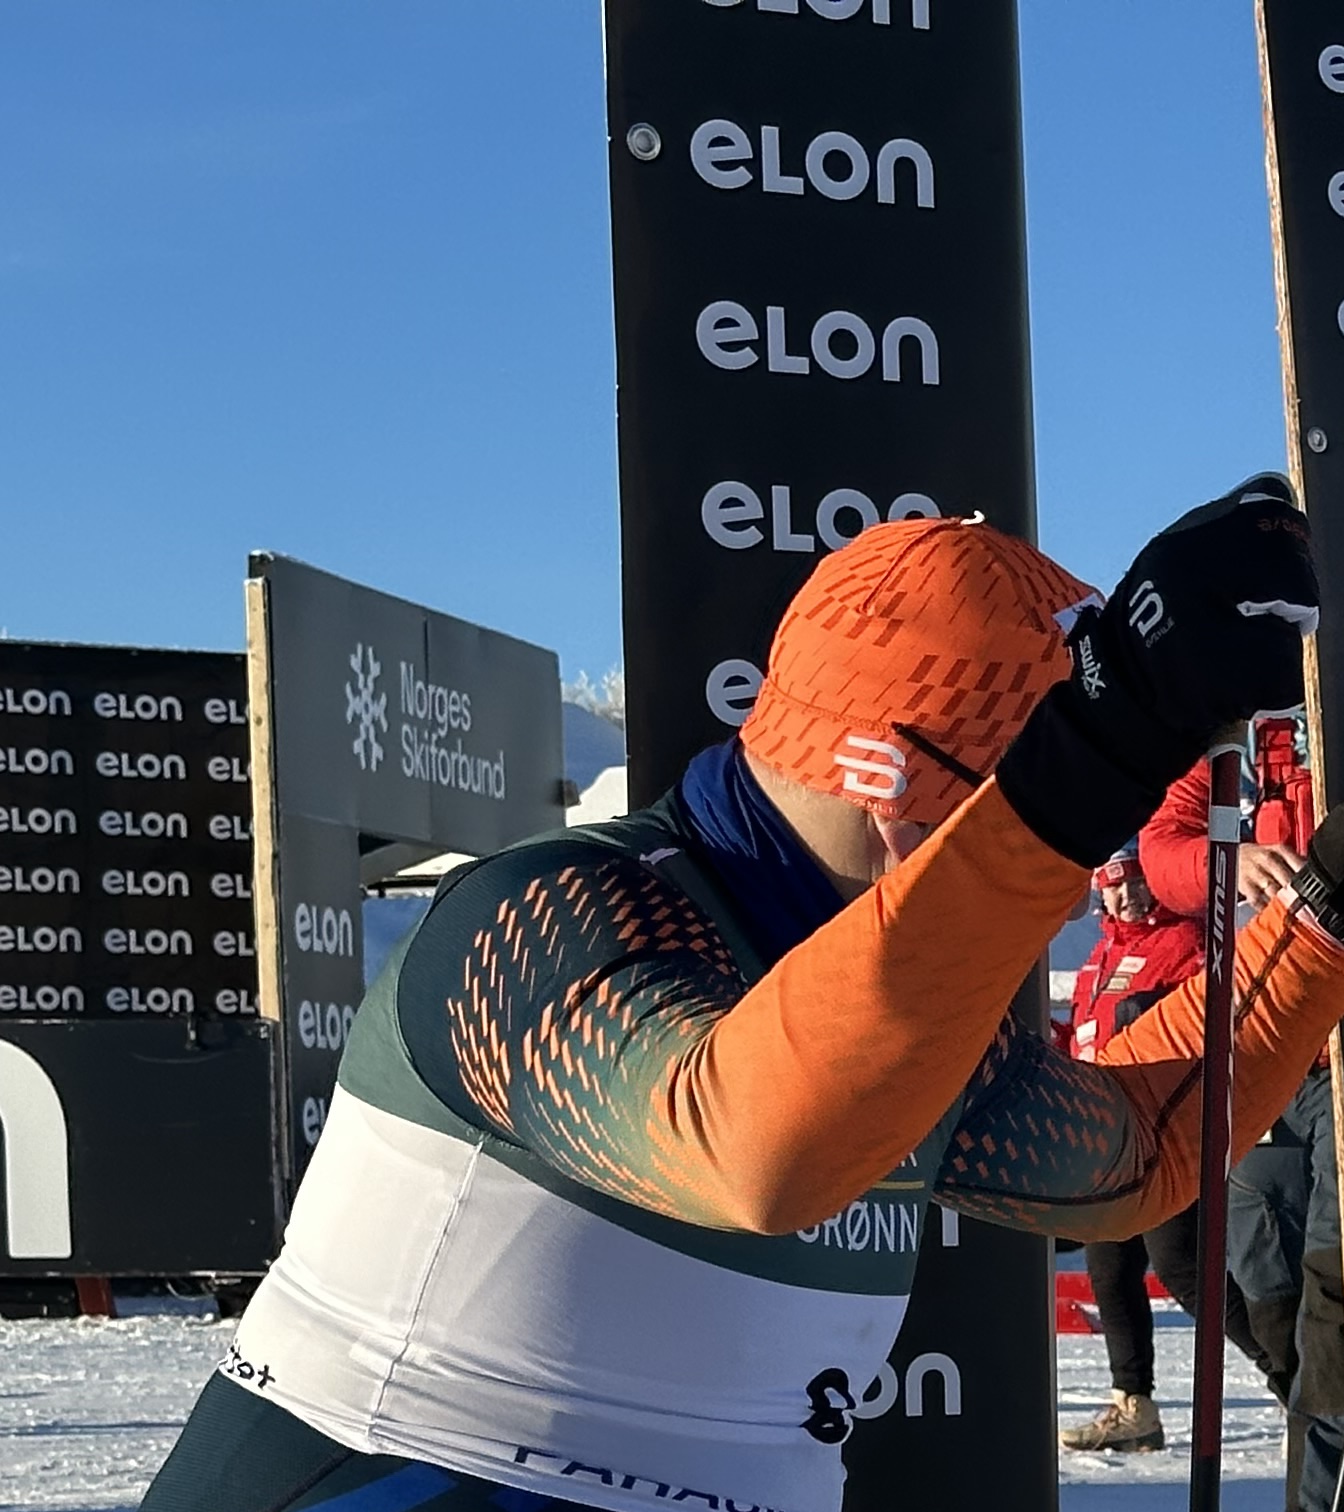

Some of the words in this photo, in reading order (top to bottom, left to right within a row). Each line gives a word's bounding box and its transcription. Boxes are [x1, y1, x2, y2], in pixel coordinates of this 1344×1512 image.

[0, 688, 72, 716] Lon
[400, 661, 471, 738] Norges
[0, 747, 74, 775] Lon
[402, 723, 505, 799] Skiforbund
